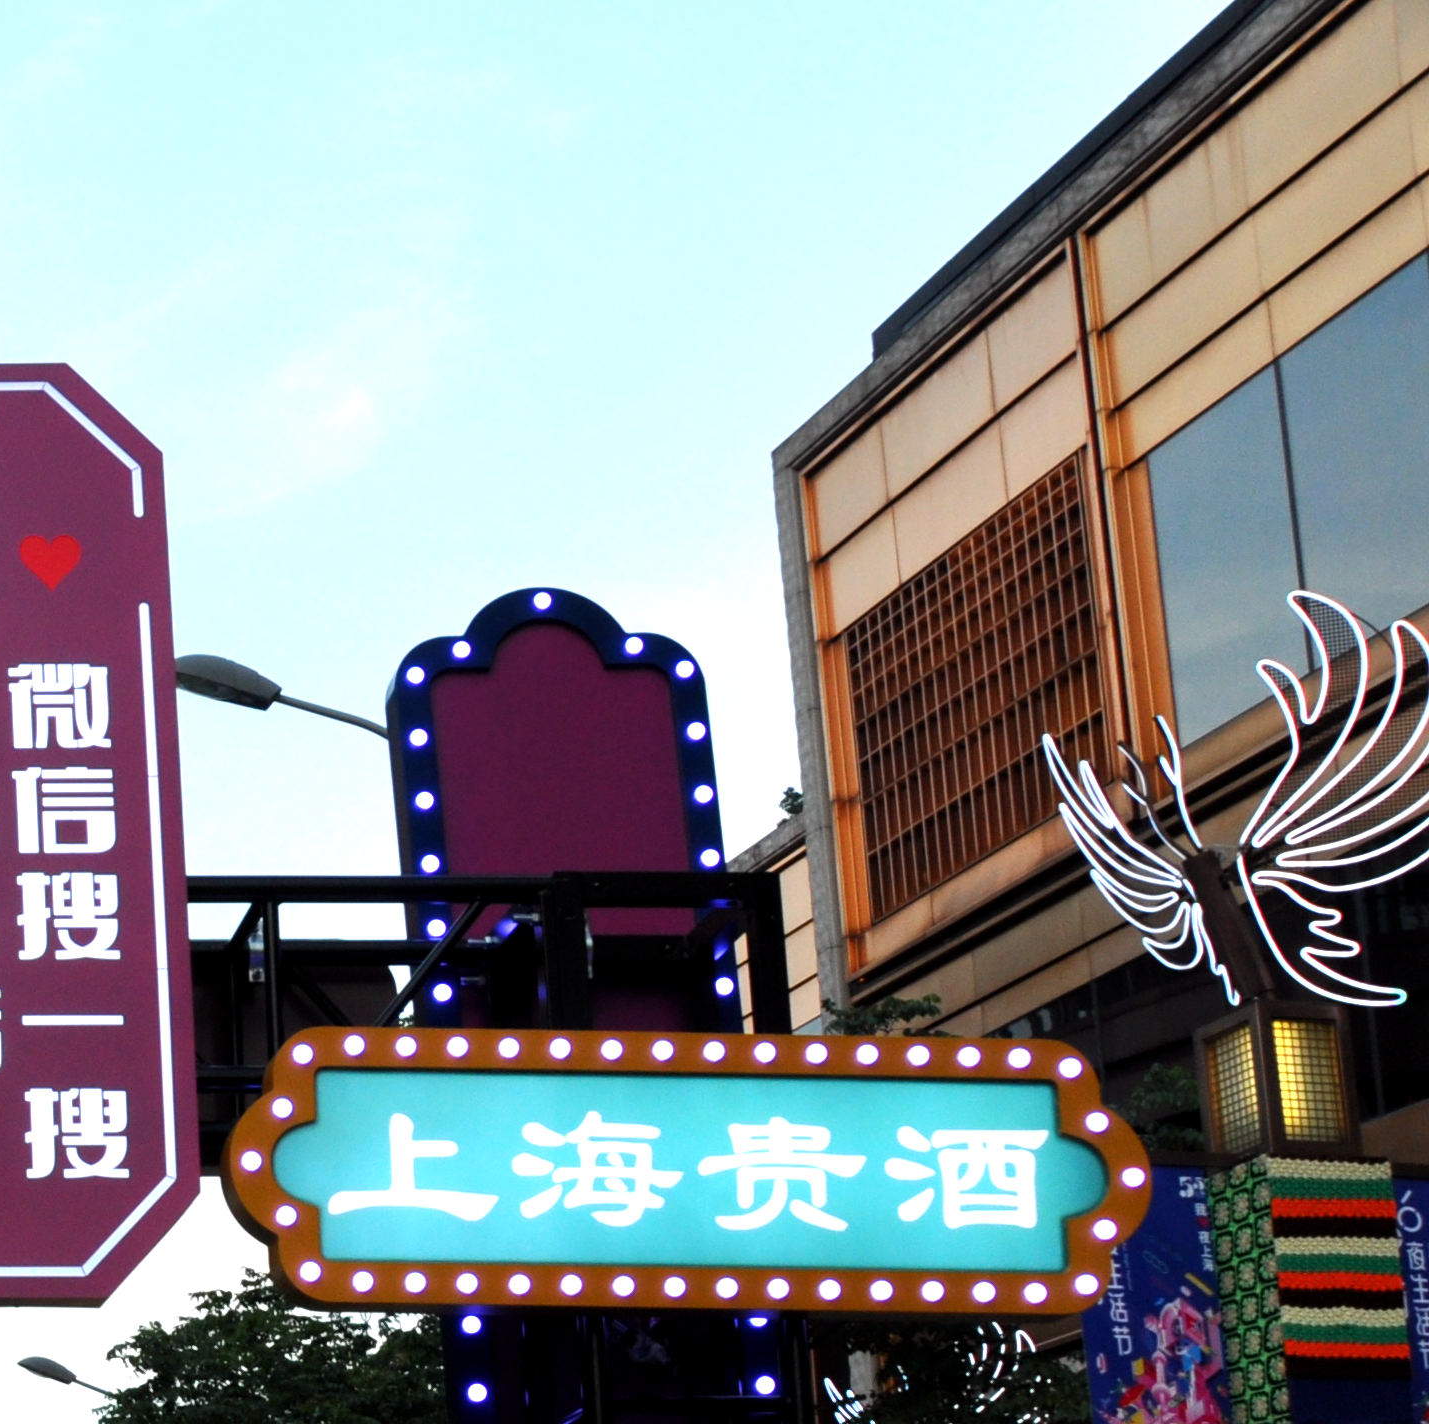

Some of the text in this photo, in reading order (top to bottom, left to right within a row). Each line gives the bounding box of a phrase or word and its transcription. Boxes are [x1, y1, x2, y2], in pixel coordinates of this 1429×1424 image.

[7, 662, 130, 1180] 微信搜一搜
[326, 1110, 1050, 1232] 上海贵酒
